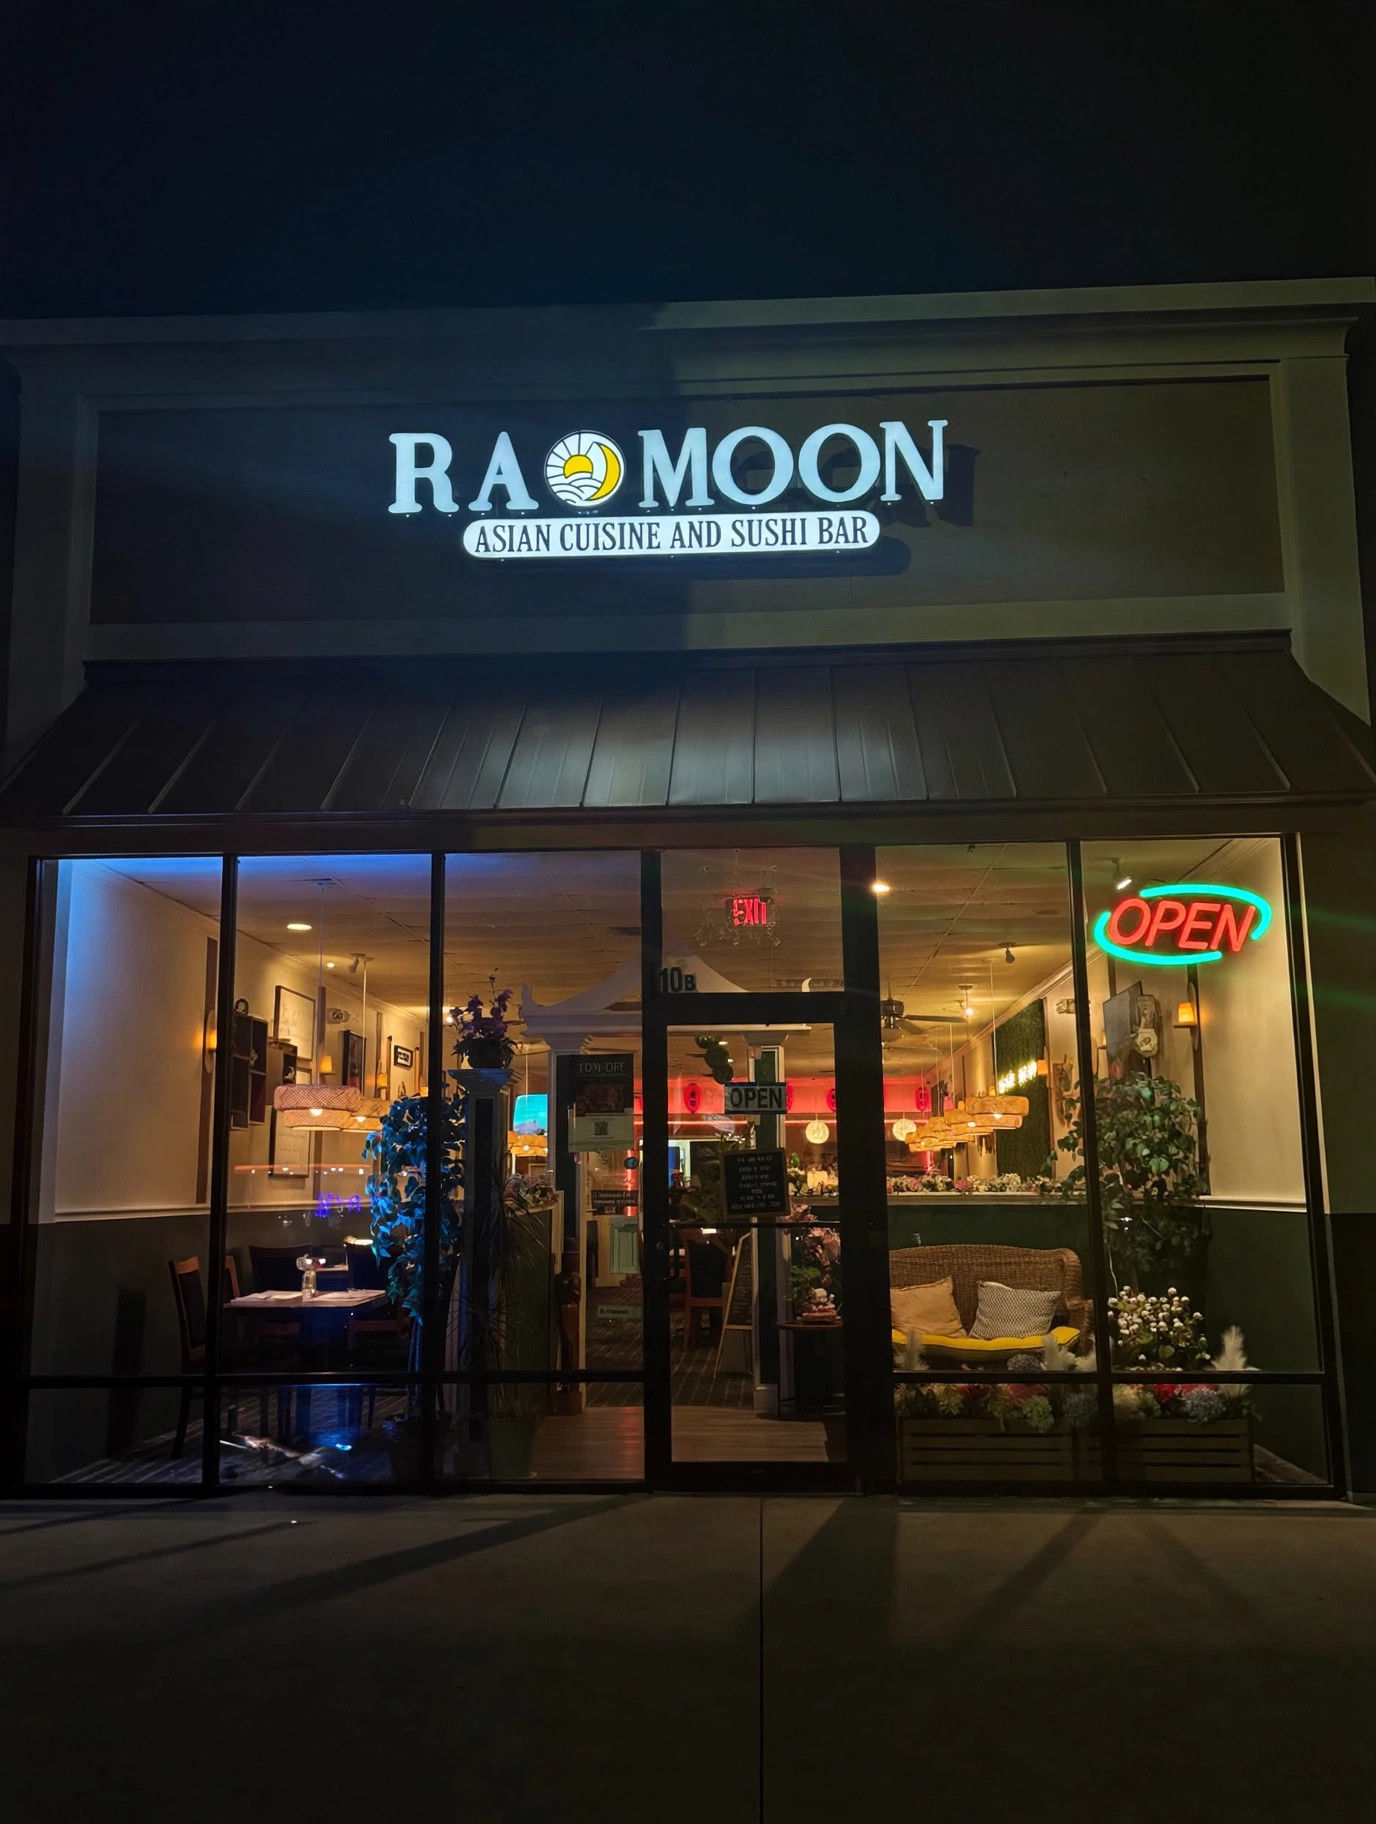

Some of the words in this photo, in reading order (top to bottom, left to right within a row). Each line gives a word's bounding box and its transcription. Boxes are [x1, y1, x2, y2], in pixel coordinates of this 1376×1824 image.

[388, 431, 539, 514] RA
[637, 419, 949, 508] MOON
[475, 524, 551, 553] ASIAN
[559, 521, 661, 551] CUISINE
[670, 520, 722, 549] AND
[731, 517, 807, 547] SUSHI
[817, 515, 869, 544] BAR
[733, 898, 767, 926] EXIT
[1108, 898, 1256, 952] OPEN
[659, 966, 697, 993] 10B
[730, 1086, 783, 1109] OPEN
